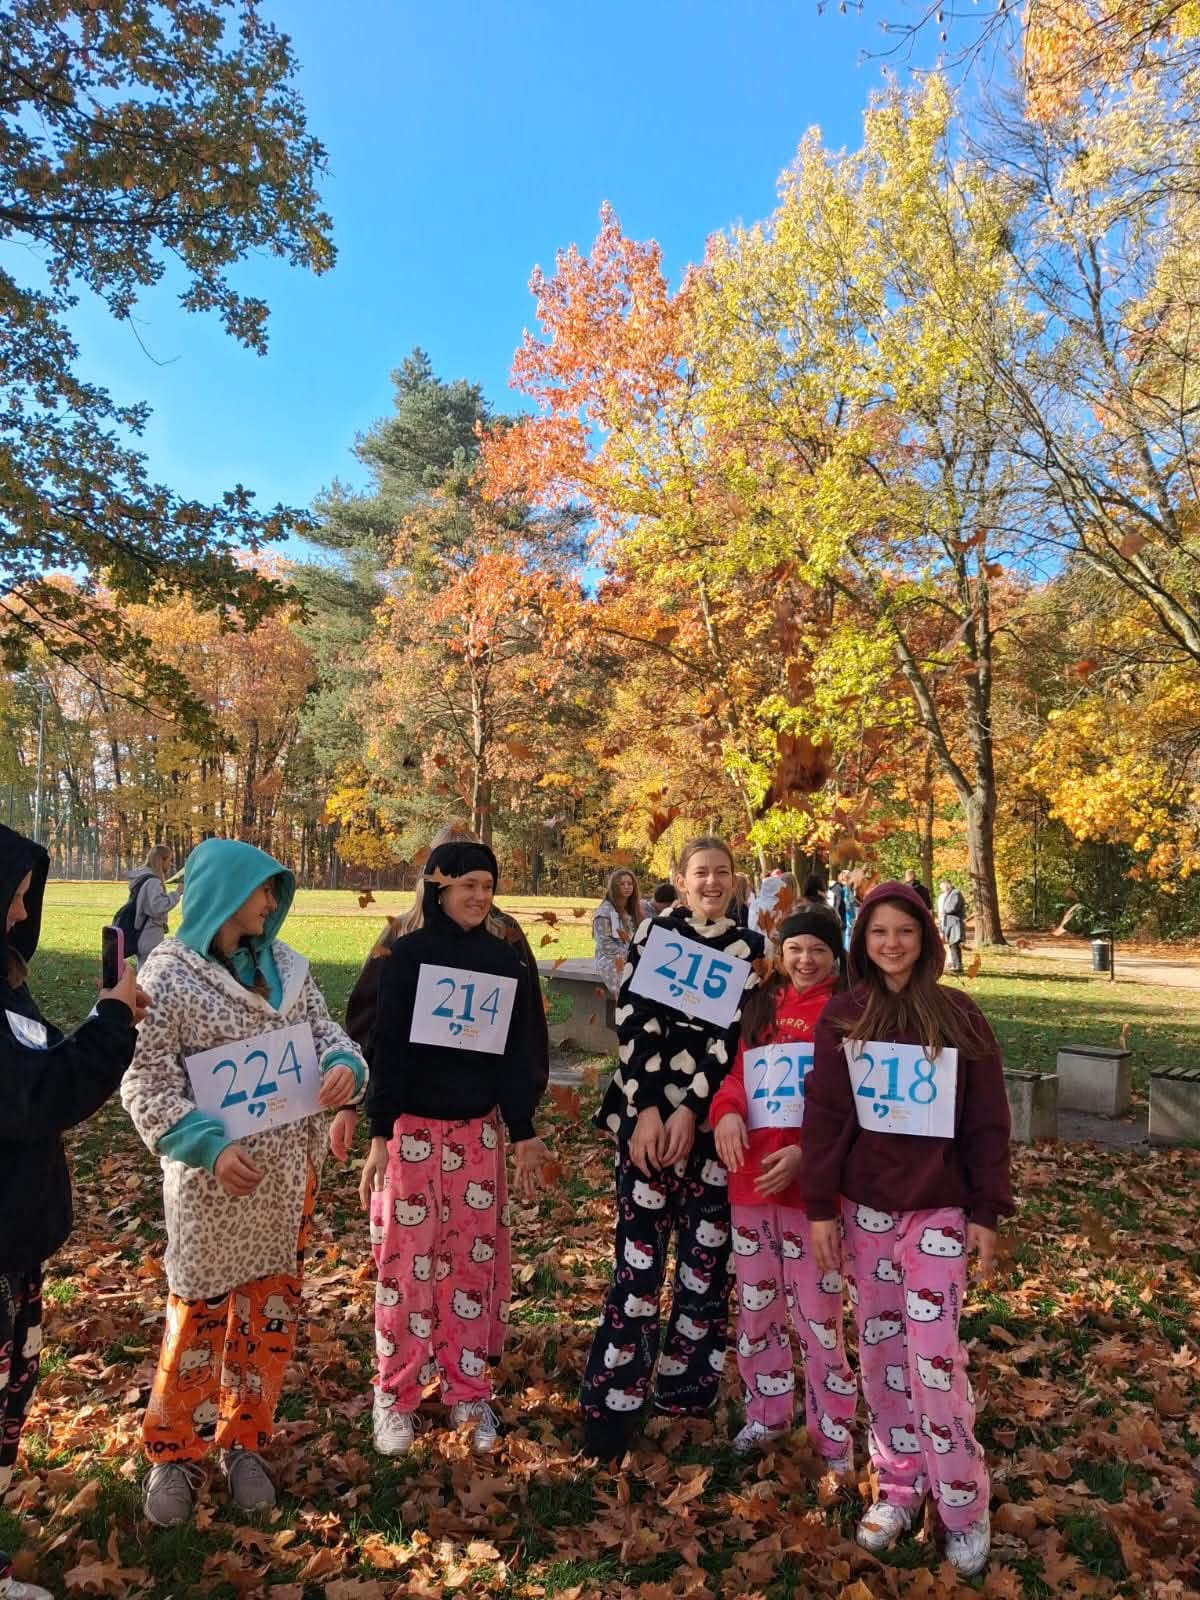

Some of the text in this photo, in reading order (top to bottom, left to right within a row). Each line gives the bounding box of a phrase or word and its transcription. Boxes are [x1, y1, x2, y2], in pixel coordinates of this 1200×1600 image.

[654, 942, 733, 999] 215
[432, 978, 500, 1025] 214
[775, 1017, 810, 1033] ERRY
[212, 1040, 302, 1109] 224
[855, 1052, 937, 1105] 218
